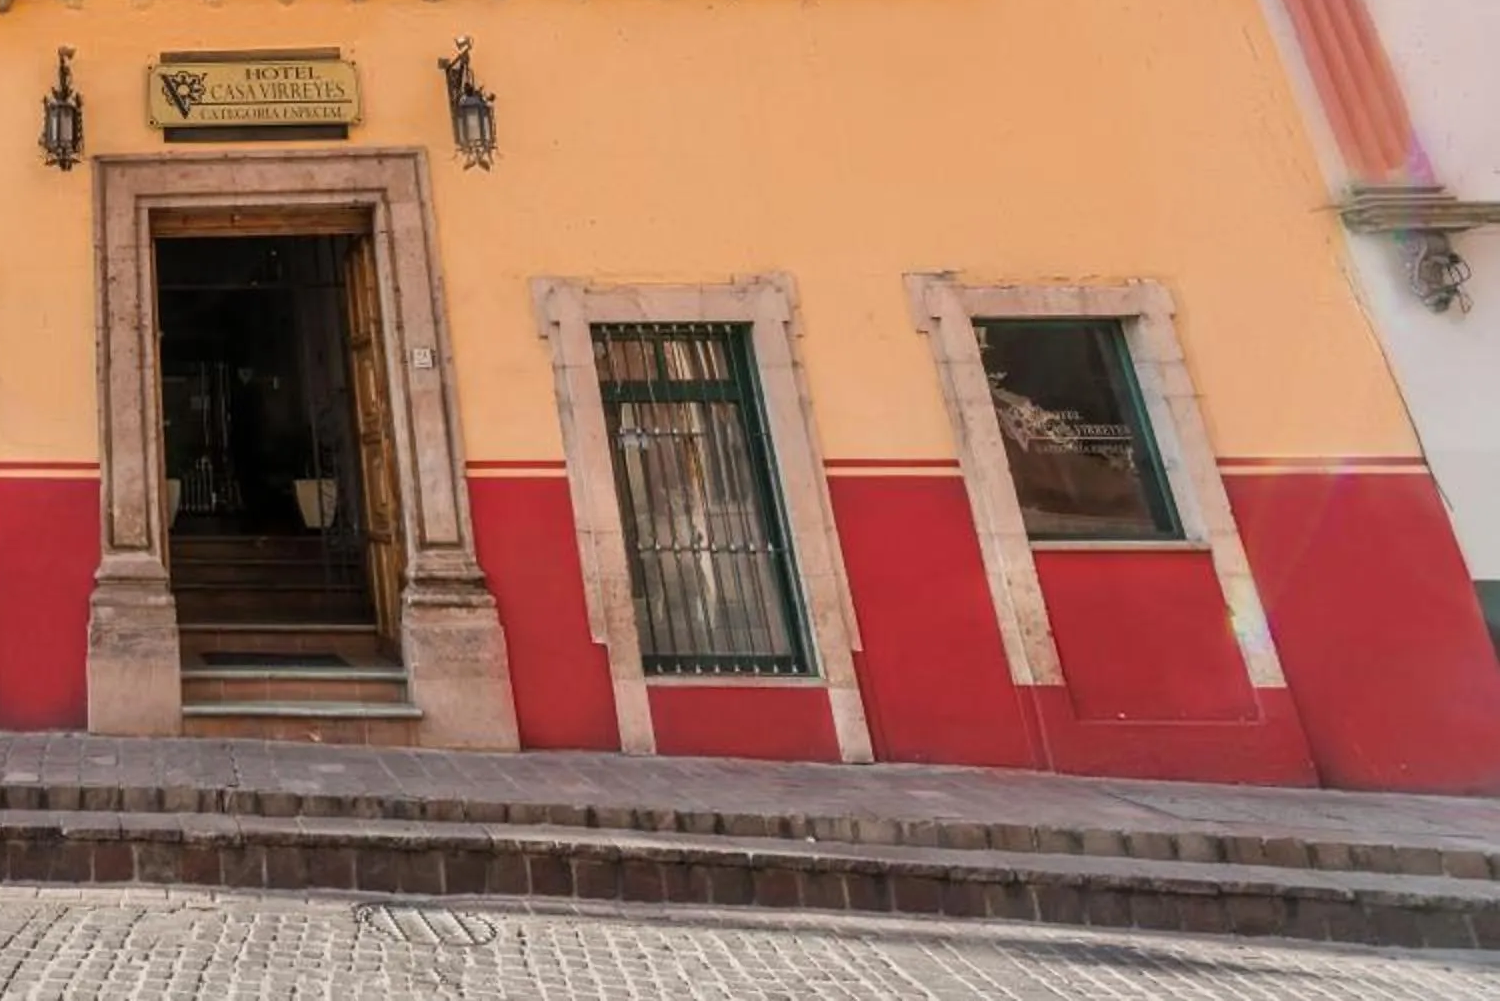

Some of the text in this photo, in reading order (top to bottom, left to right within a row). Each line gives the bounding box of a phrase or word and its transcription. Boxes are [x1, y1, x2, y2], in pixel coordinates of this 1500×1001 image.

[245, 66, 318, 80] HOTEL
[210, 80, 346, 101] CASA VIRREYES
